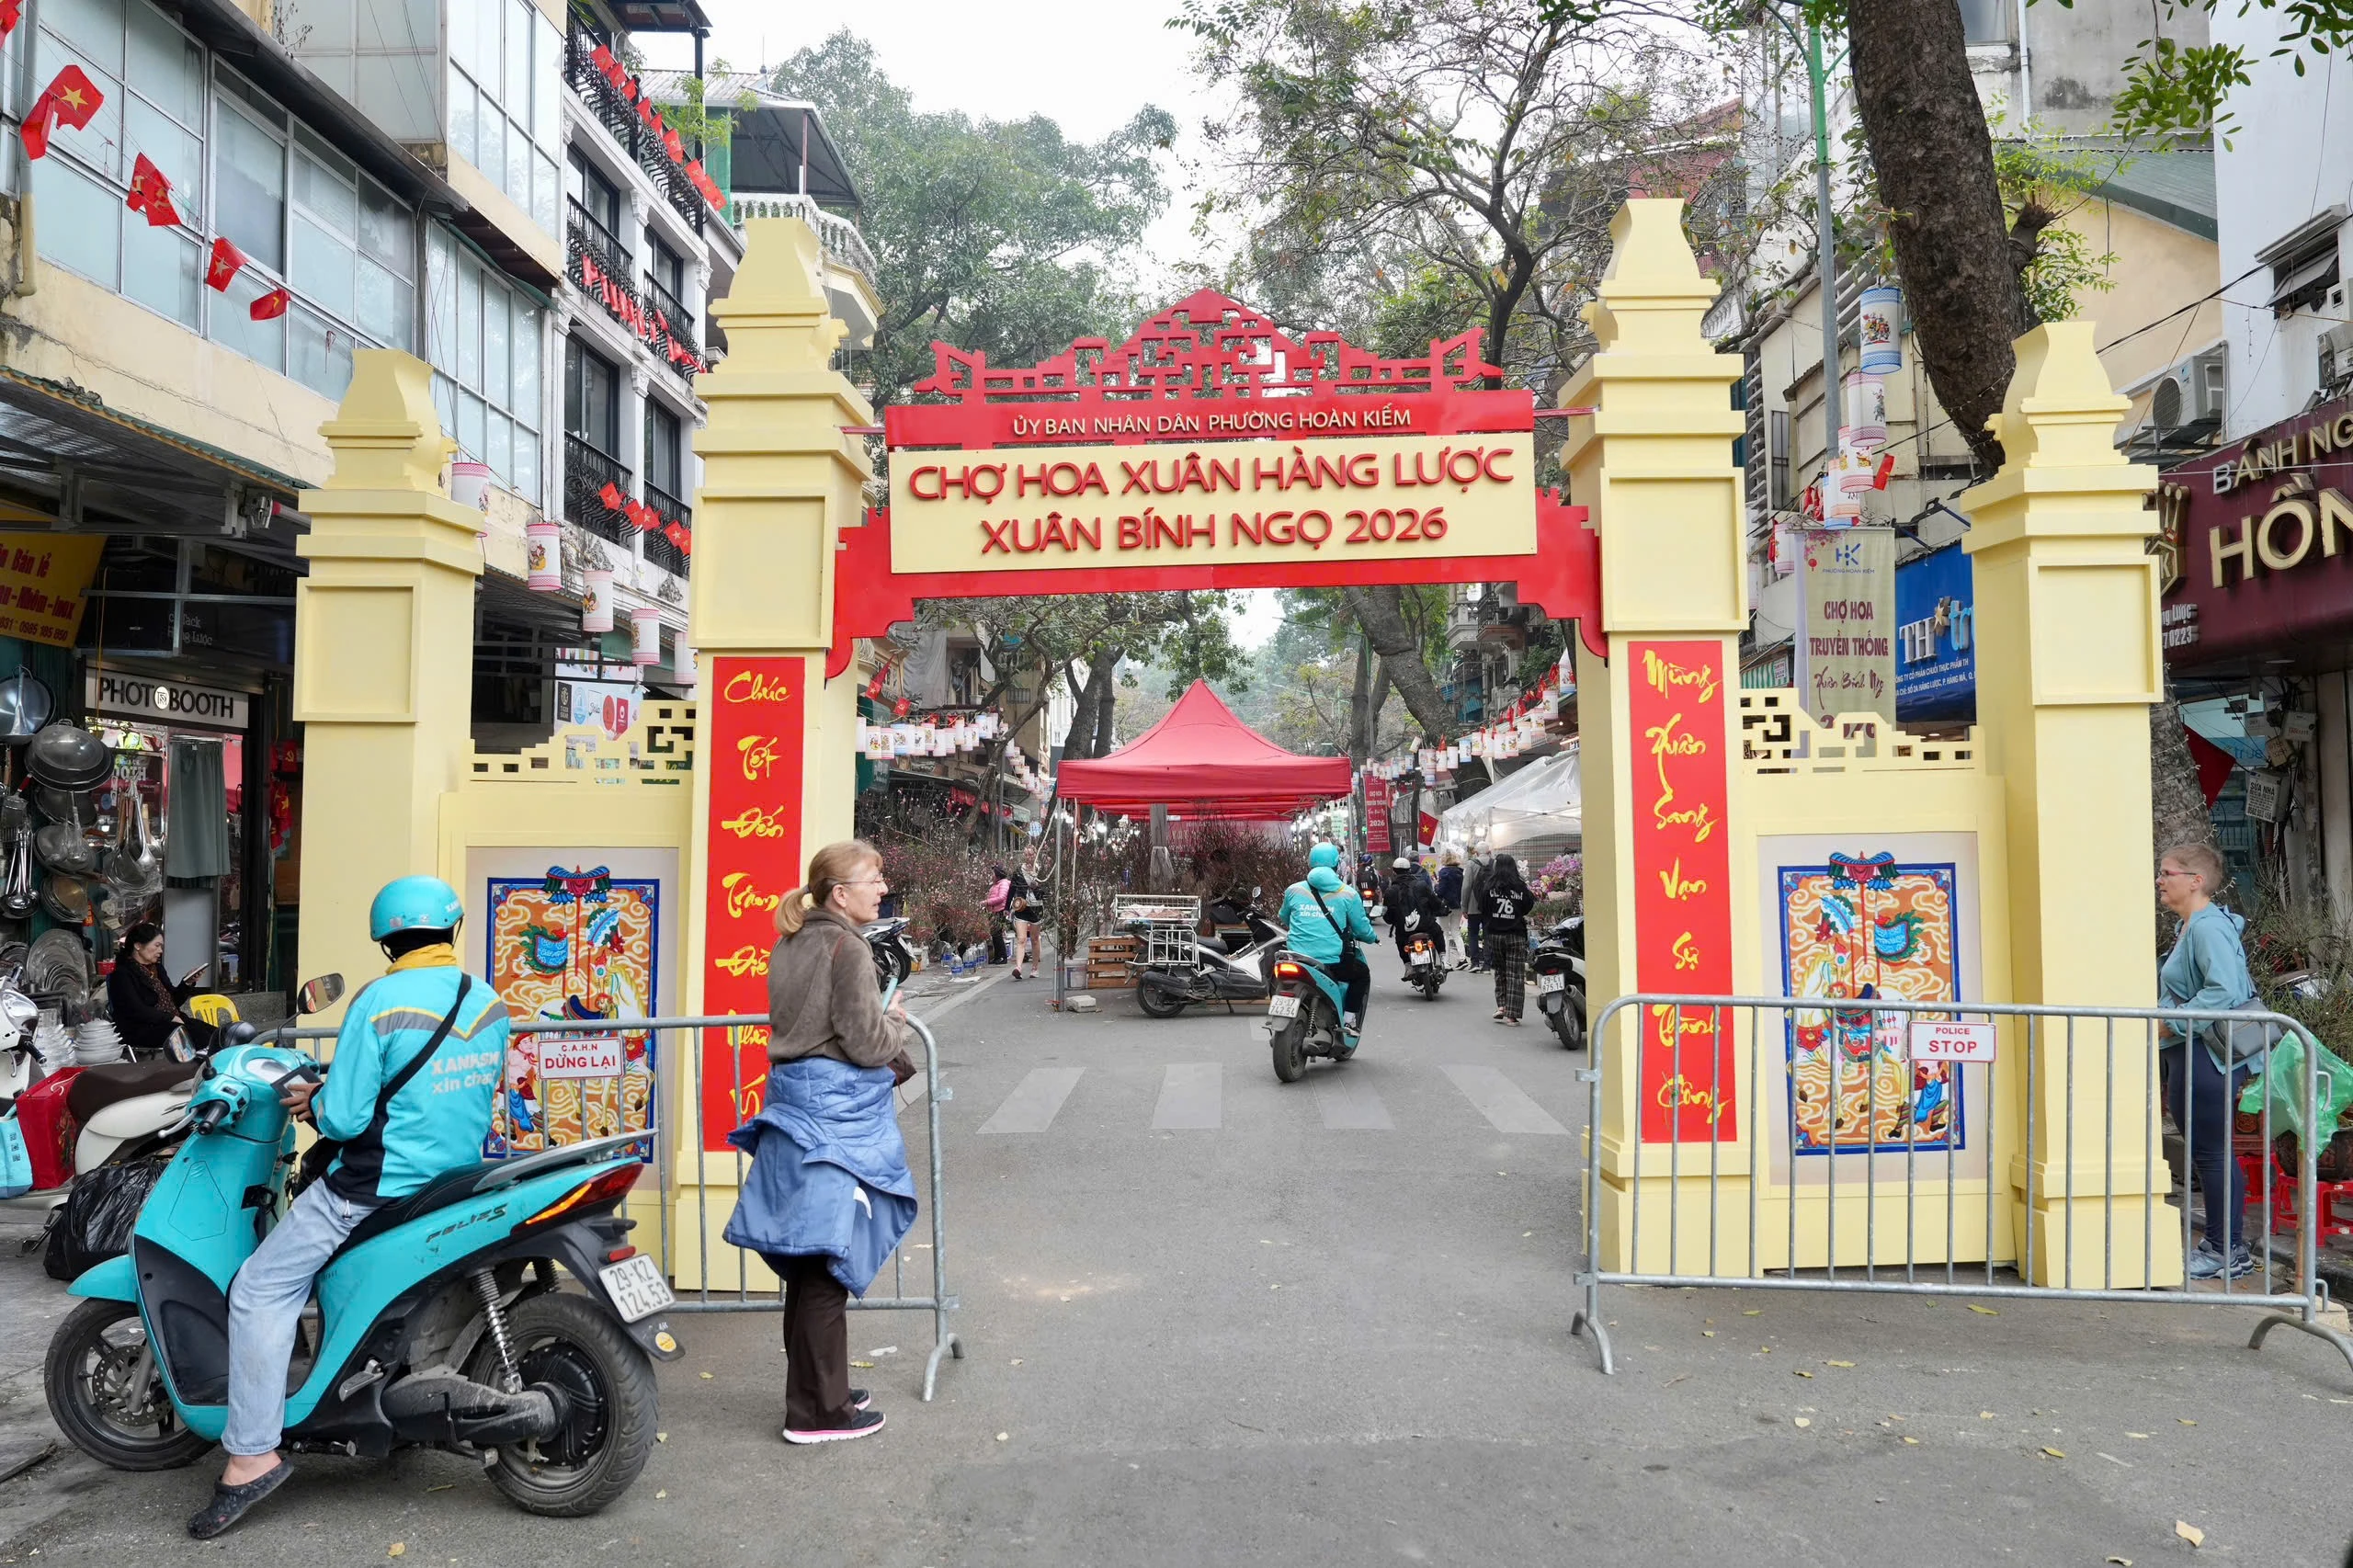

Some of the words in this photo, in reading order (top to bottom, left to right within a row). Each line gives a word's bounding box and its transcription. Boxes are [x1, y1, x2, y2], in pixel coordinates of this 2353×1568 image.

[1013, 414, 1040, 436] ỦY
[1045, 417, 1086, 435] BAN
[1094, 414, 1151, 434] NHÂN
[1157, 412, 1199, 433] DÂN
[1209, 409, 1293, 431] PHƯỜNG
[1299, 407, 1356, 429] HOÀN
[1363, 402, 1411, 426] KIẾM
[909, 461, 1007, 505] CHỢ
[1017, 461, 1109, 497] HOA
[1120, 451, 1240, 494] XUÂN
[1255, 445, 1380, 491] HÀNG
[1394, 445, 1515, 494] LƯỢC
[2212, 434, 2299, 495] BÁNH
[981, 511, 1102, 553] XUÂN
[1118, 506, 1216, 550] BÍNH
[1231, 508, 1333, 551] NGỌ
[1345, 506, 1449, 543] 2026
[1824, 598, 1847, 624] CHỢ
[1850, 601, 1874, 619] HOA
[1810, 630, 1849, 656] TRUYỀN
[1852, 630, 1889, 656] THỐNG
[1899, 616, 1937, 665] TH
[724, 670, 790, 703] Chúc
[1642, 649, 1722, 703] Mừng
[737, 734, 781, 780] Tết
[1645, 712, 1707, 781] Xuân
[721, 804, 784, 838] Đến
[1654, 787, 1721, 844] Sang
[1659, 856, 1707, 901] Vạn
[1496, 898, 1514, 915] 76
[715, 945, 770, 978] Điề
[1672, 931, 1699, 971] Sự
[562, 1043, 597, 1052] C.A.H.N
[1928, 1040, 1977, 1053] STOP
[1935, 1027, 1971, 1035] POLICE
[545, 1053, 587, 1069] DỪNG
[591, 1055, 616, 1070] LẠI
[433, 1076, 460, 1095] xin
[620, 1281, 670, 1317] 124.53
